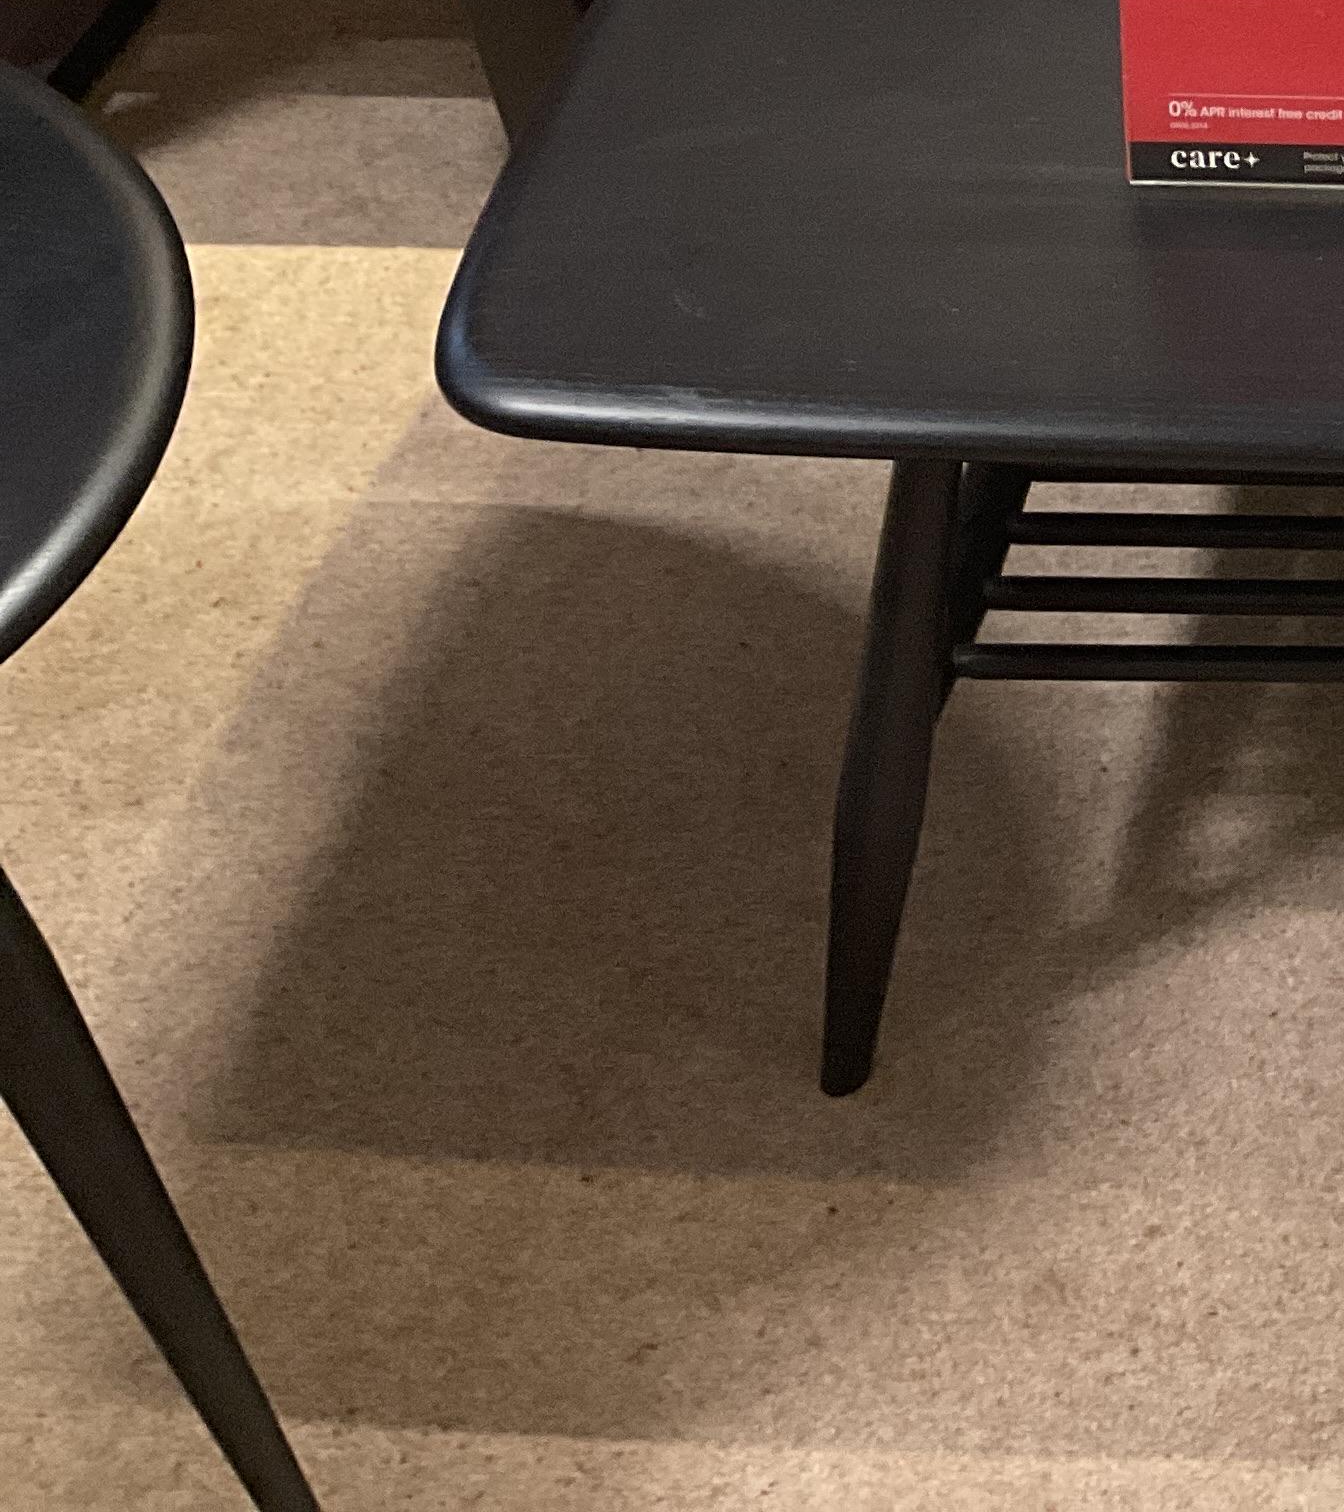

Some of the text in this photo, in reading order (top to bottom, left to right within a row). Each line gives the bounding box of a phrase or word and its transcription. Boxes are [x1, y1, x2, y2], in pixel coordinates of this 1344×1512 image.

[1168, 100, 1343, 120] 0% APR interest free credit
